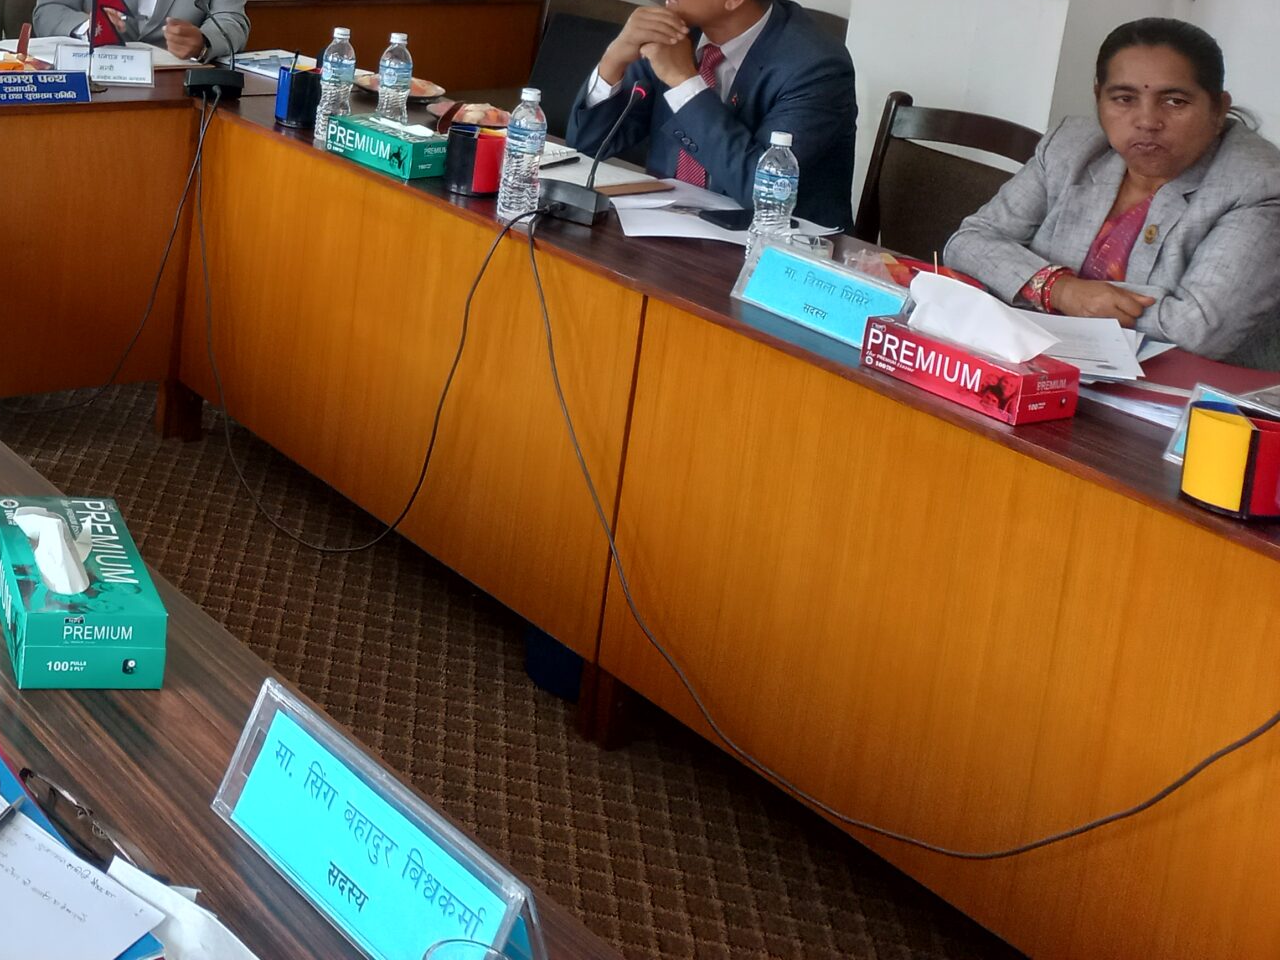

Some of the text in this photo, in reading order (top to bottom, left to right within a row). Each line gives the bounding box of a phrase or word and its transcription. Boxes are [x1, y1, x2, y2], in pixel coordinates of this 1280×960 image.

[37, 74, 66, 84] पन्थ
[327, 124, 391, 160] PREMIUM
[803, 303, 828, 320] सदस्य
[867, 328, 982, 392] PREMIUM
[1037, 378, 1067, 391] PREMIUM
[71, 500, 139, 584] PREMIUM
[63, 626, 133, 640] PREMIUM
[47, 661, 69, 671] 100
[275, 740, 297, 778] मा.
[303, 761, 339, 809] सिंग
[344, 800, 398, 867] बहादुर
[327, 861, 369, 913] सदस्य
